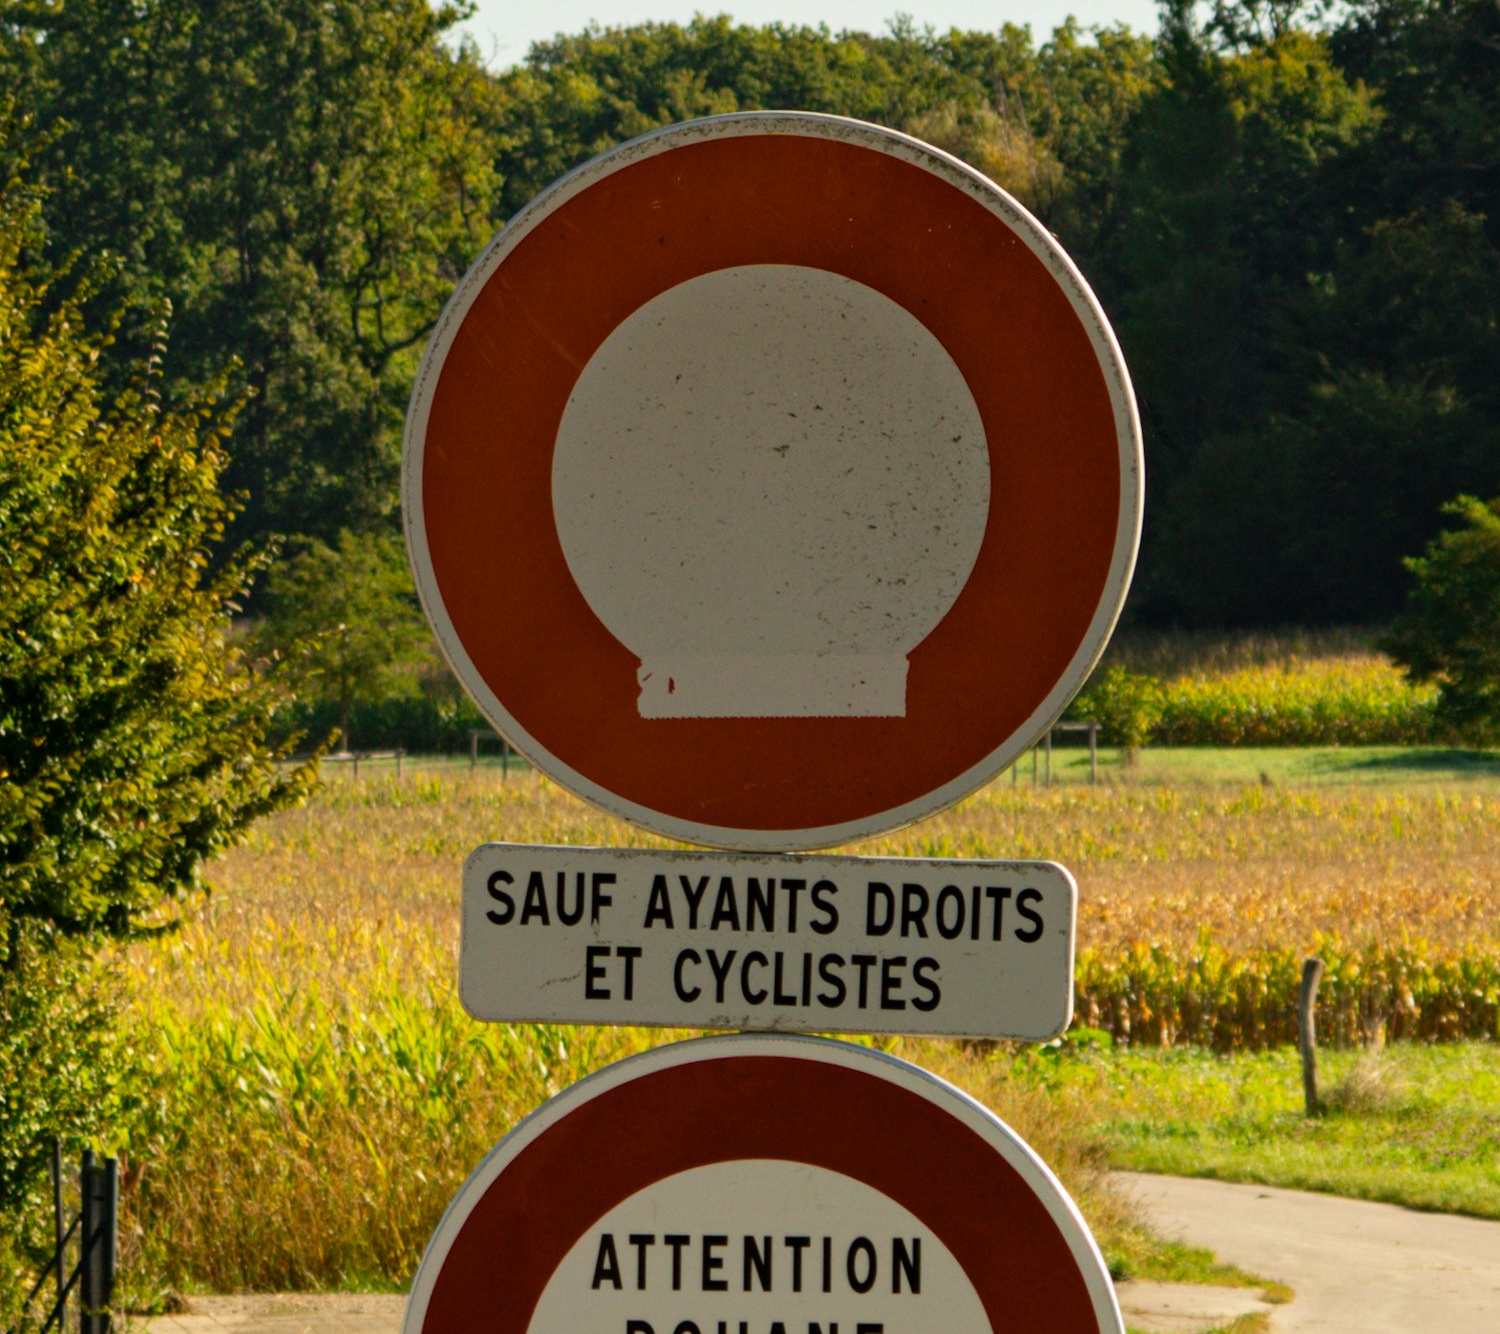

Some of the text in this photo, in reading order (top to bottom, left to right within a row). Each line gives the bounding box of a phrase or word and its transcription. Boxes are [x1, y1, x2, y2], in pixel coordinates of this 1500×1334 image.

[486, 870, 1045, 943] SAUF AYANTS DROITS
[585, 945, 941, 1012] ET CYCLISTES
[592, 1234, 921, 1294] ATTENTION
